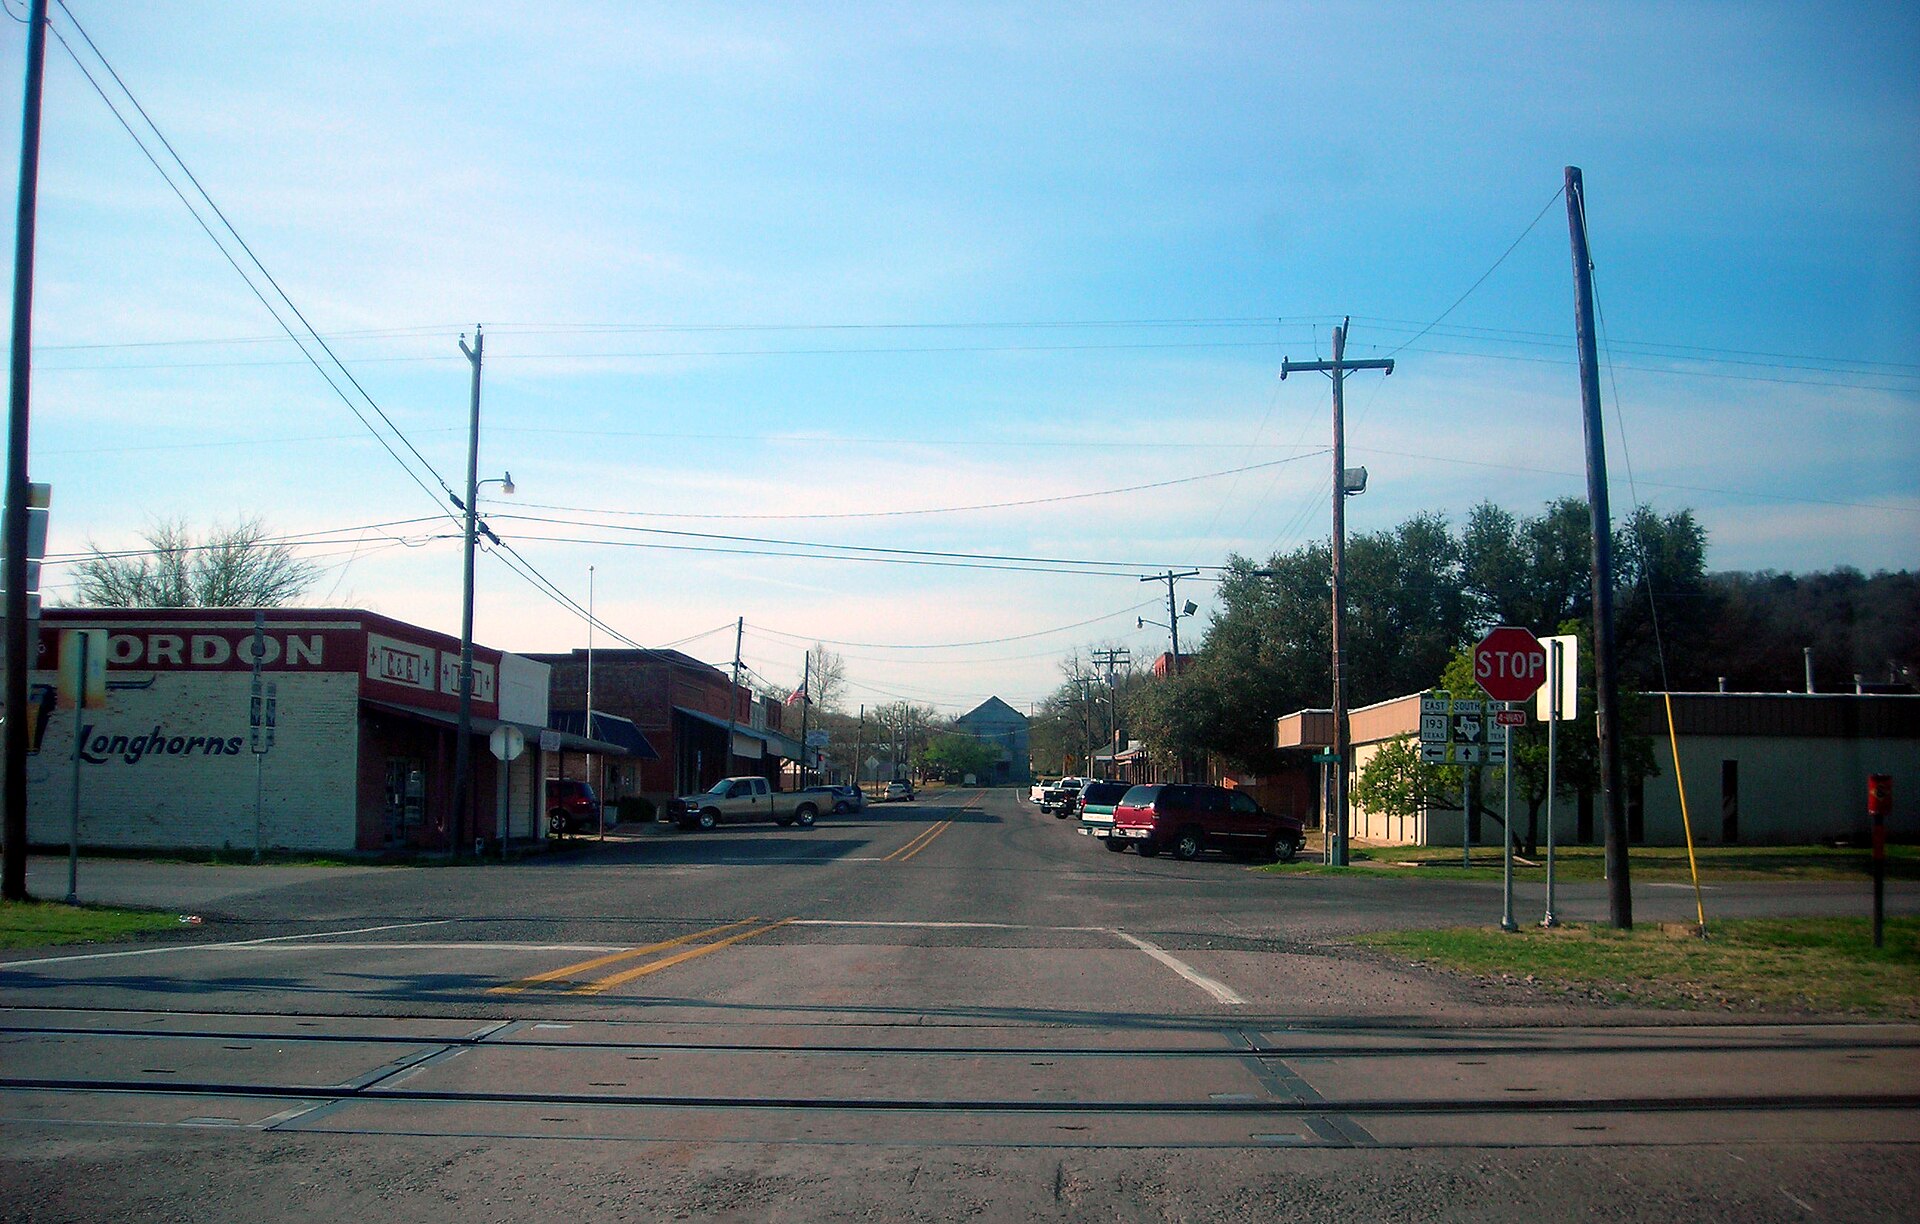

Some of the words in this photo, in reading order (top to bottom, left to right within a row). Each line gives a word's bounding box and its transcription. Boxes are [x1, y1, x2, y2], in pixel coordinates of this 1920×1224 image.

[106, 634, 324, 665] ORDON
[1477, 651, 1544, 678] STOP
[1425, 702, 1445, 710] EAST
[1454, 702, 1481, 711] SOUTH
[1489, 702, 1506, 711] WES
[1498, 713, 1524, 723] 4-WAY
[1425, 720, 1443, 729] 193
[1463, 723, 1477, 731] 919
[71, 725, 243, 764] Longhorns
